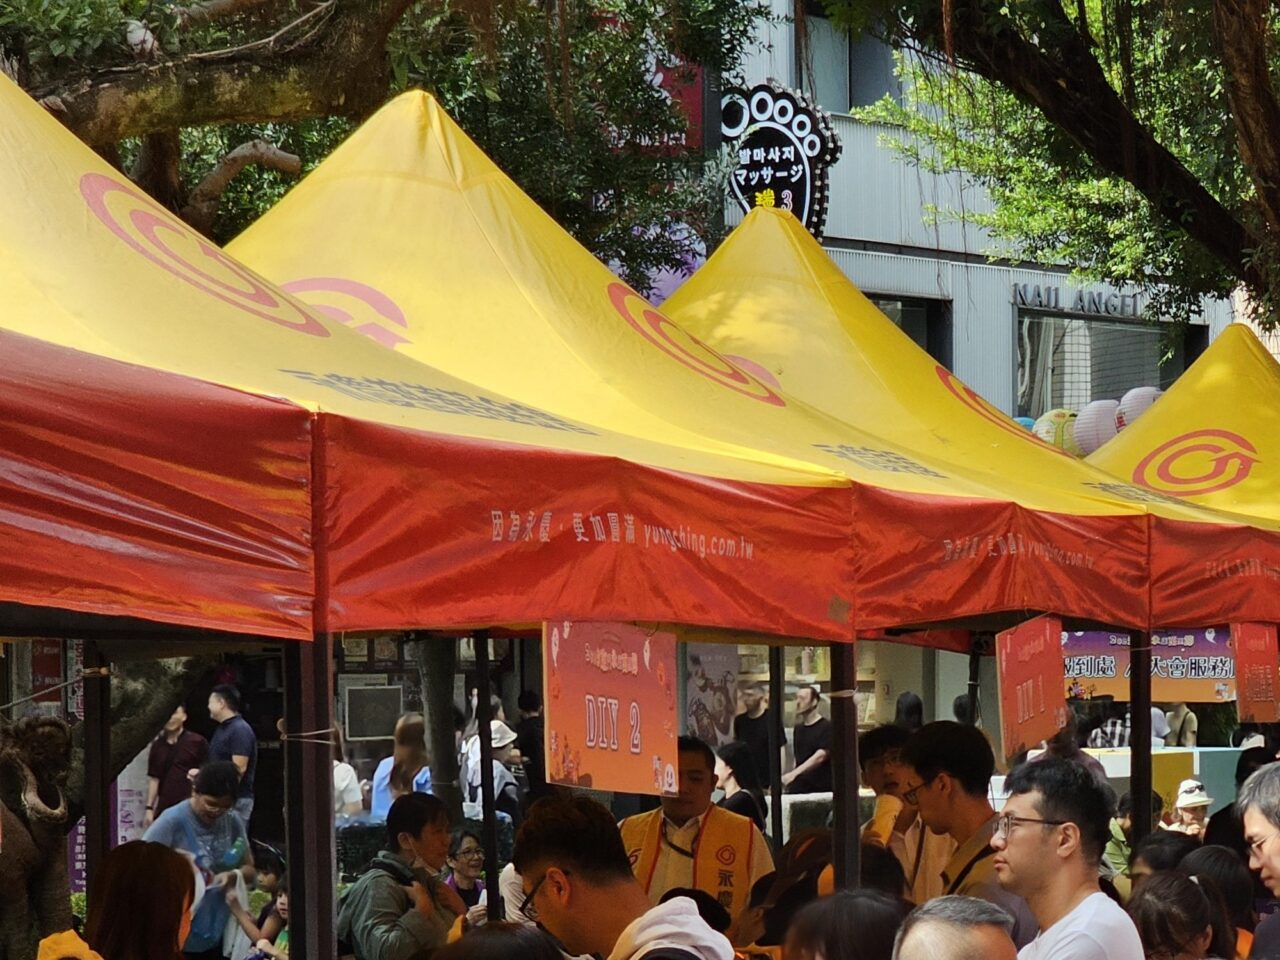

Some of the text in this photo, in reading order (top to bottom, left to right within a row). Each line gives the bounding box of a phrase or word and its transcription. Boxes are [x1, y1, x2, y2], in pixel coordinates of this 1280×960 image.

[735, 164, 803, 186] マッサージ
[1012, 282, 1065, 312] NAIL
[644, 524, 754, 560] yungching.com.tw
[1151, 655, 1235, 679] 大會服務
[585, 694, 641, 754] DIY 2
